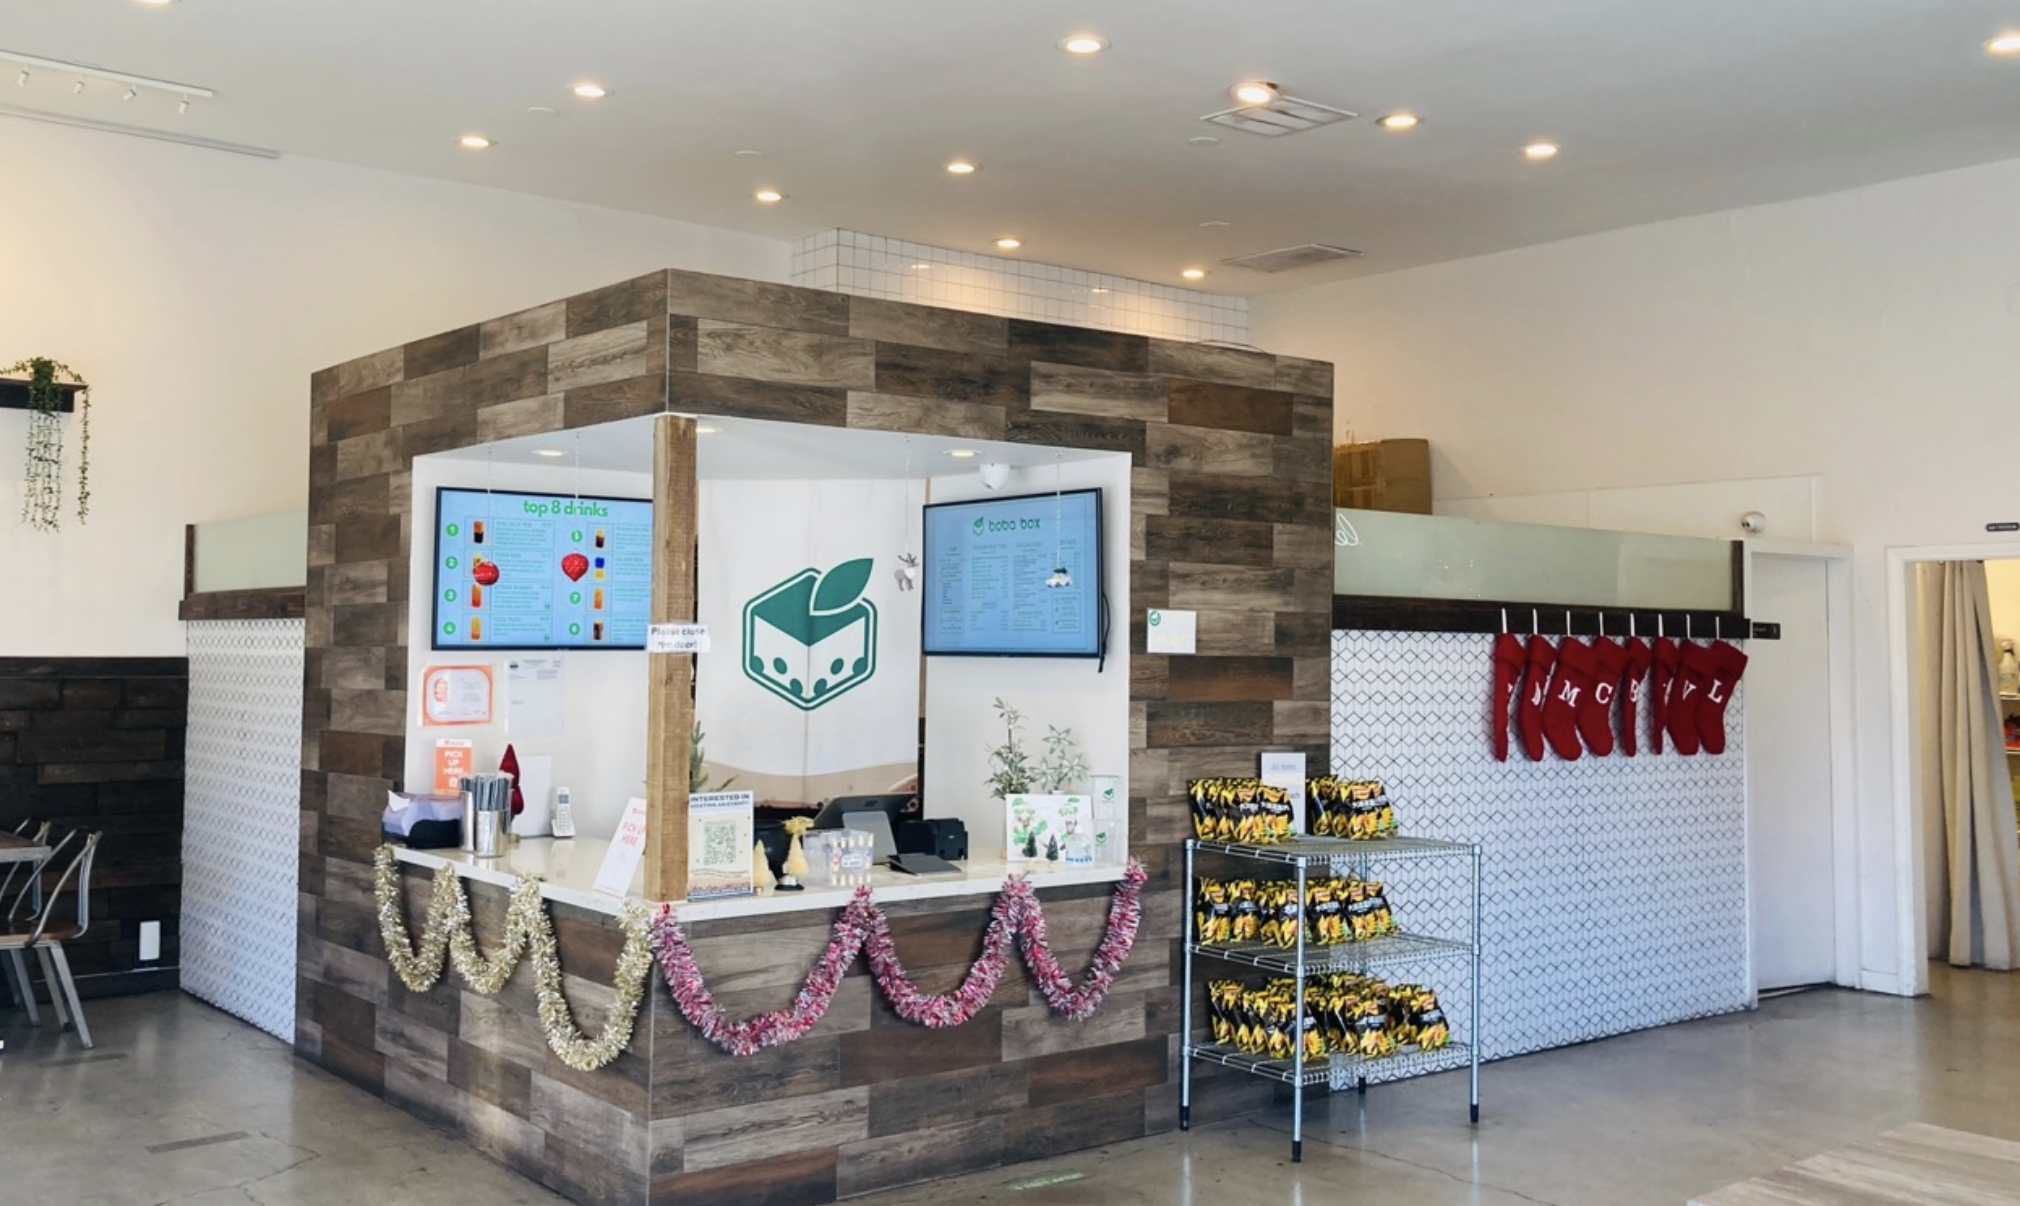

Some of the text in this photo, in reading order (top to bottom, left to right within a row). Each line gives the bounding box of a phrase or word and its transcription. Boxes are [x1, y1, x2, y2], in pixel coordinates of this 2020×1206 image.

[523, 500, 609, 517] top 8 drinks
[988, 517, 1041, 532] boba box
[651, 626, 705, 636] Please close
[1557, 678, 1582, 708] M
[1594, 682, 1613, 704] C
[1706, 678, 1723, 704] L
[448, 759, 460, 767] UP
[690, 794, 740, 802] INTERESTED
